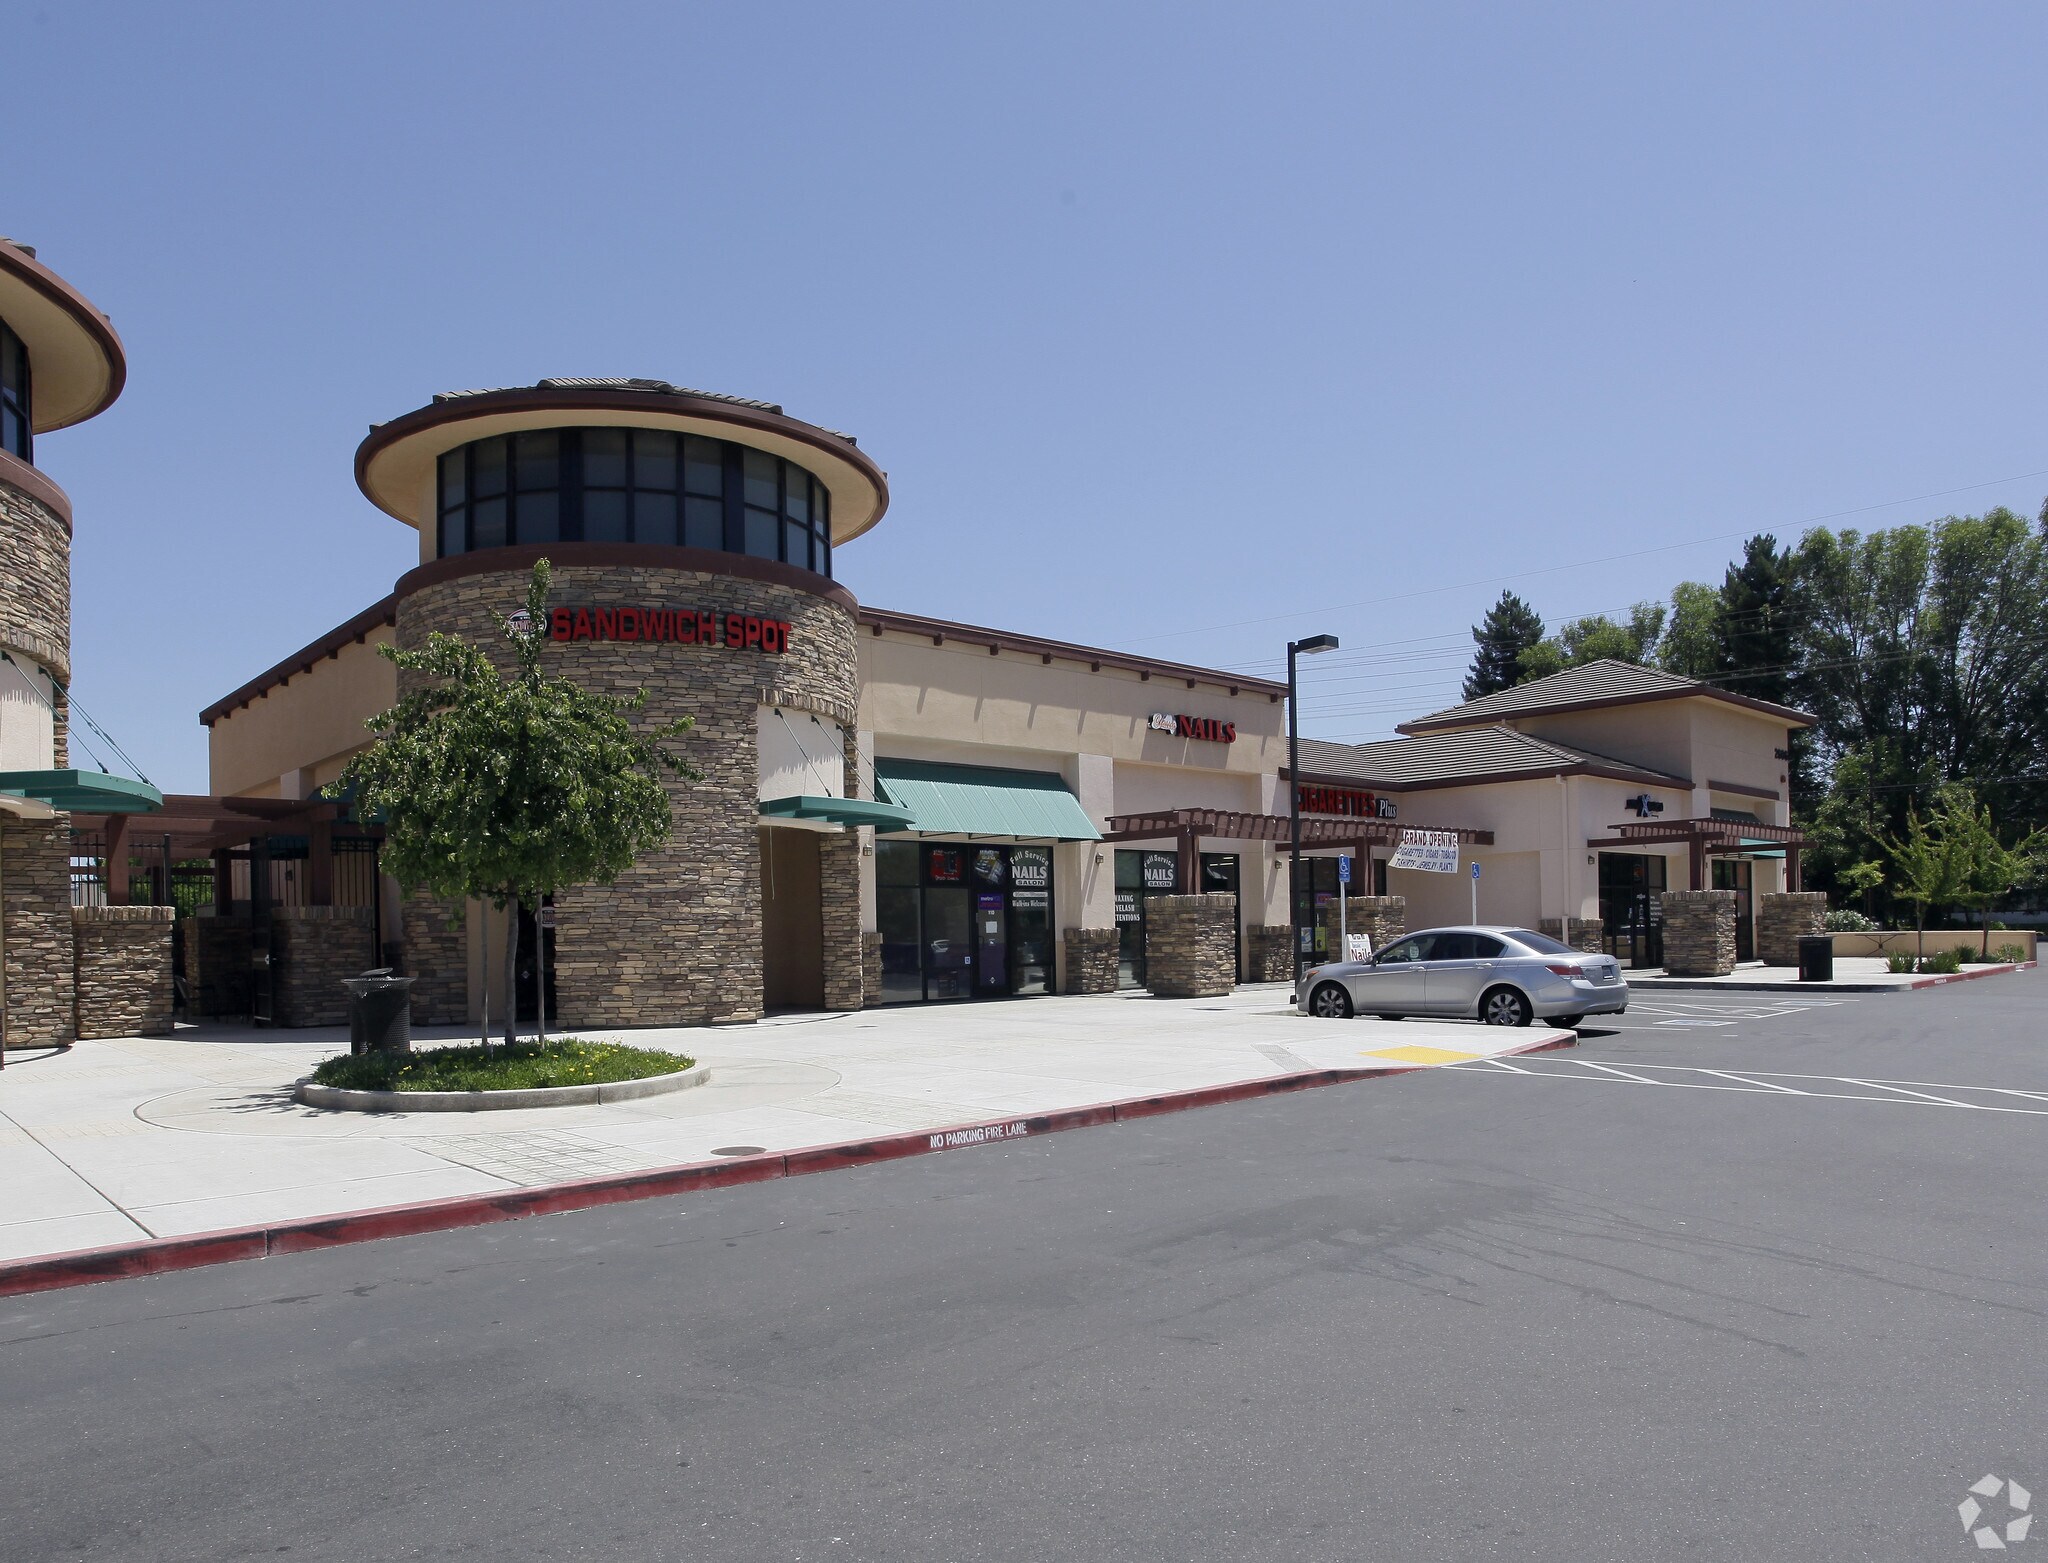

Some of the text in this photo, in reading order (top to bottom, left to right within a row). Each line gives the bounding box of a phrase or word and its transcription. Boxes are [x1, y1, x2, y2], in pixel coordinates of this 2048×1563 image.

[551, 607, 716, 645] SANDWICH
[726, 613, 792, 653] SPOT
[1175, 714, 1237, 744] NAILS
[1298, 786, 1398, 818] CIGARETTES Plus
[1404, 831, 1457, 848] GRAND OPENING
[1010, 851, 1023, 865] Full
[1024, 850, 1049, 866] Service
[1397, 847, 1424, 858] CIGARETTES
[1154, 854, 1175, 869] Service
[1011, 865, 1048, 879] NAILS
[1144, 868, 1174, 881] NAILS
[1115, 904, 1135, 912] YELASH
[930, 1122, 1027, 1148] NO PARKING FIRE LANE
